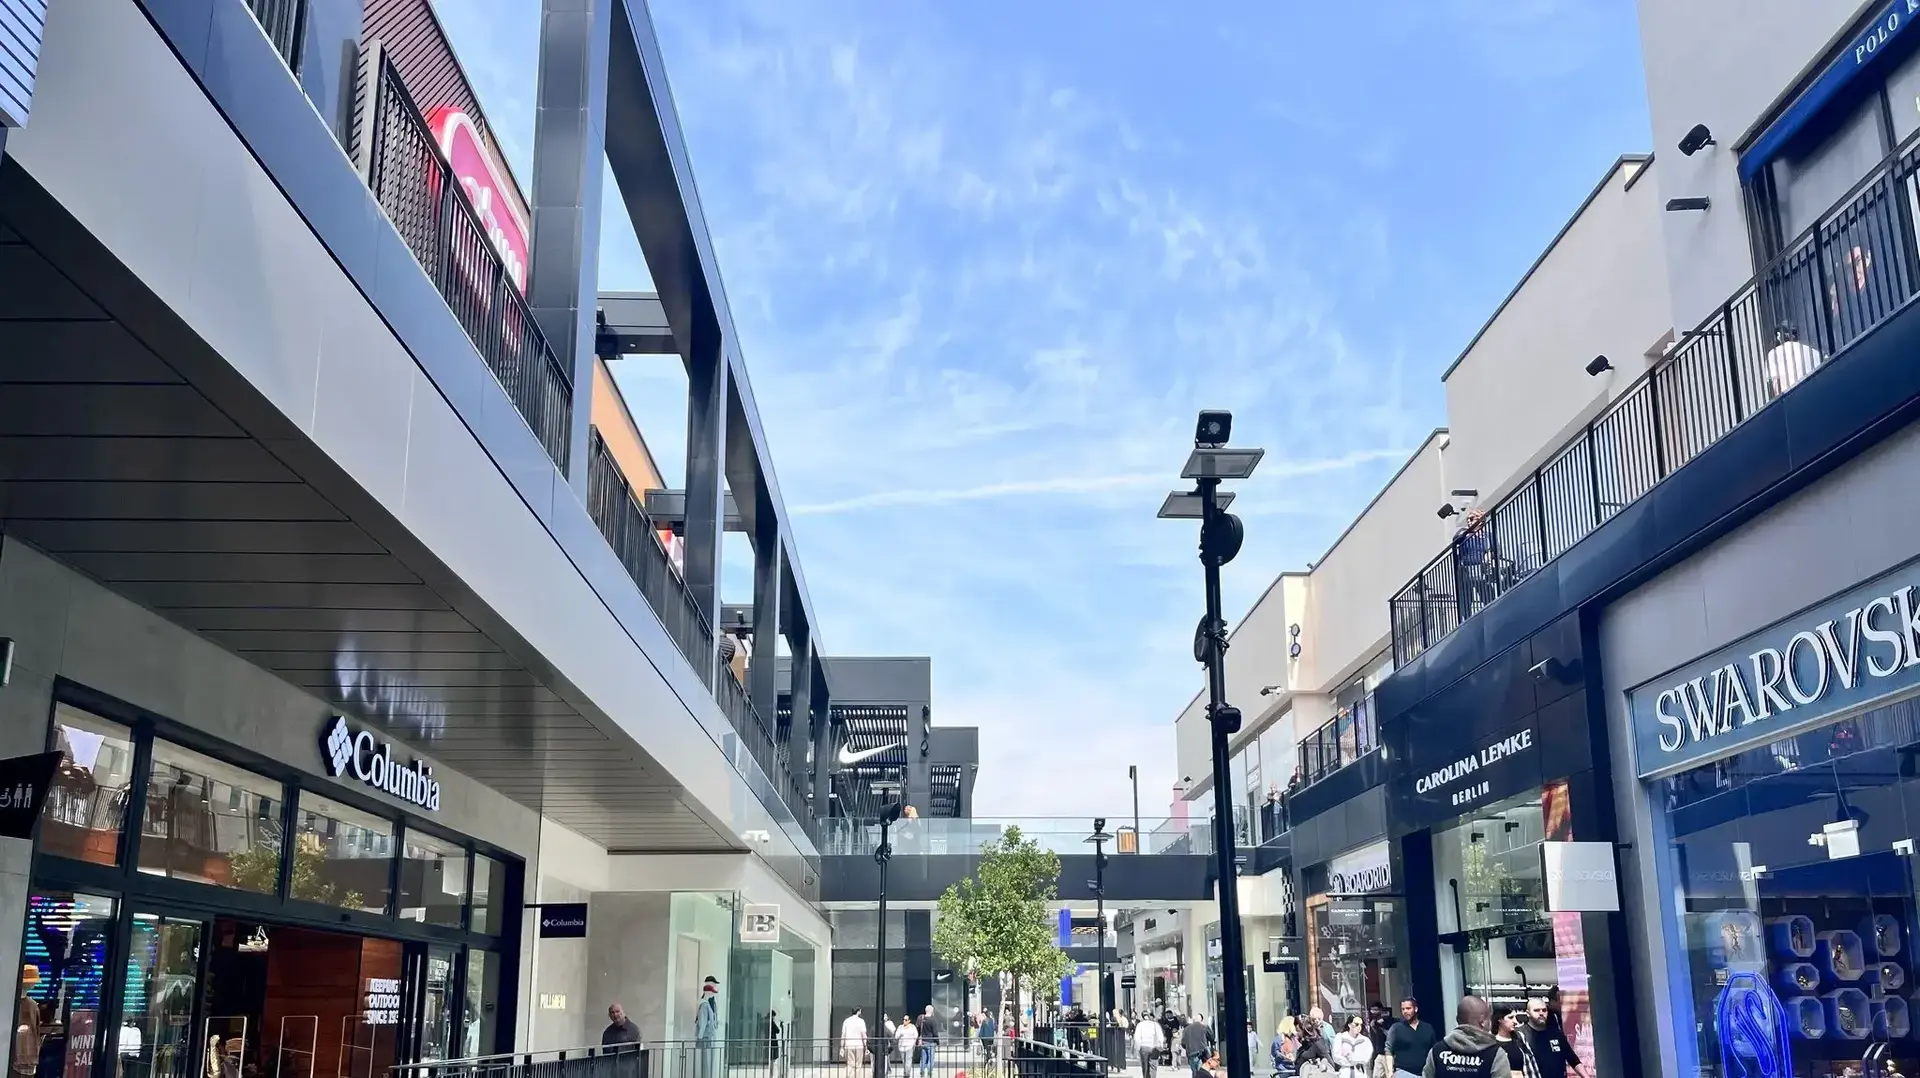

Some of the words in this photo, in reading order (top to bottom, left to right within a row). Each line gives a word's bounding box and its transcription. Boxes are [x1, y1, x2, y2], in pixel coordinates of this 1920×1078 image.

[1855, 13, 1898, 64] POLO
[354, 731, 440, 811] Columbia
[1416, 754, 1480, 793] CAROLINA
[1481, 728, 1532, 766] LEMKE
[1452, 780, 1489, 806] BERLIN
[1345, 863, 1391, 893] BOARDRID
[550, 919, 584, 927] Columbia
[369, 978, 398, 993] KEEPING
[366, 1010, 387, 1024] SINCE
